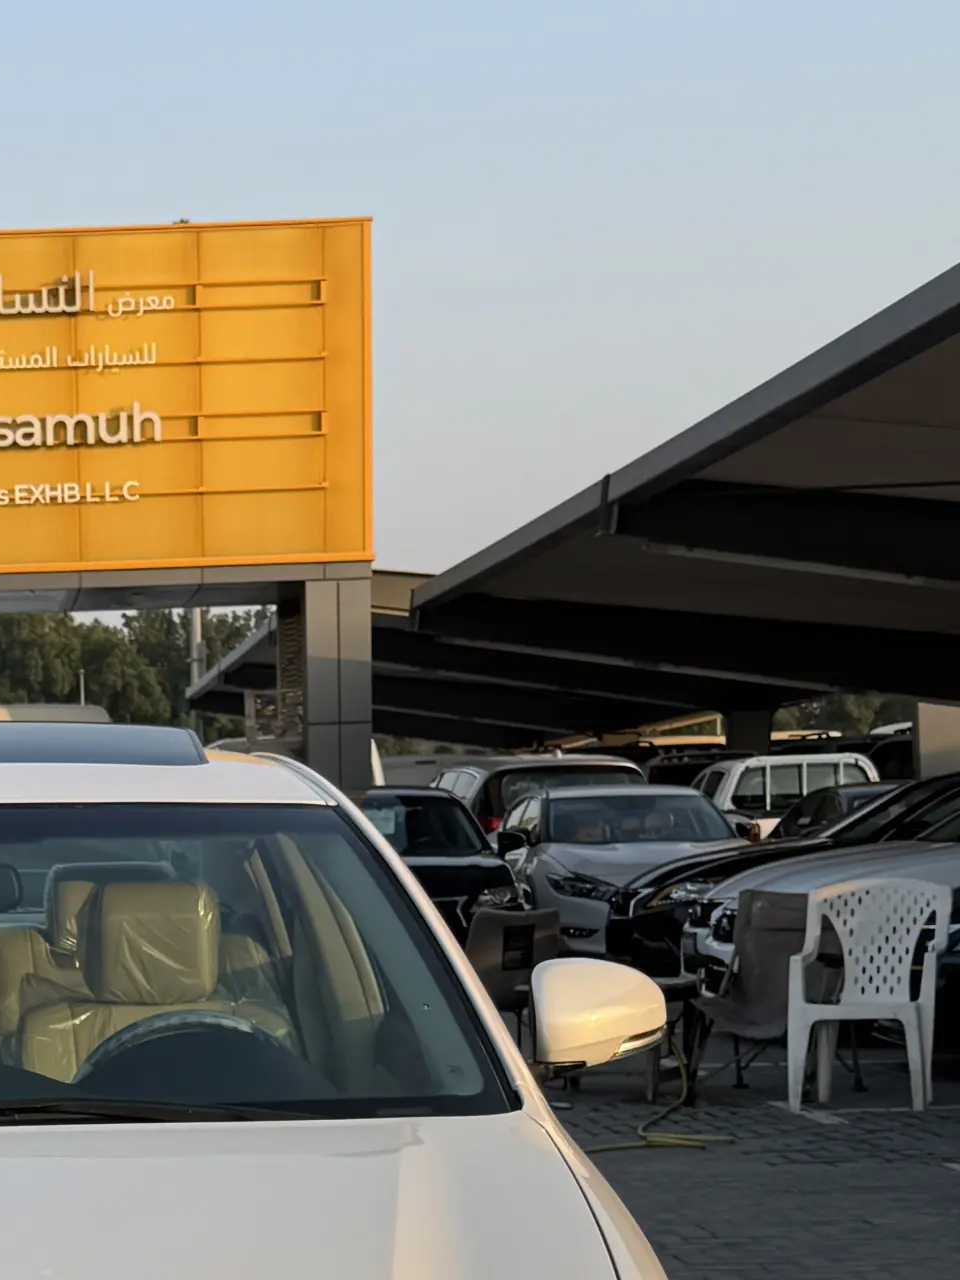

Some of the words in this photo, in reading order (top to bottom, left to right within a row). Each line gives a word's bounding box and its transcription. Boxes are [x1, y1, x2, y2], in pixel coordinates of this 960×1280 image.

[107, 291, 175, 317] معرض
[67, 342, 157, 373] للسيارات
[14, 483, 81, 505] EXHB
